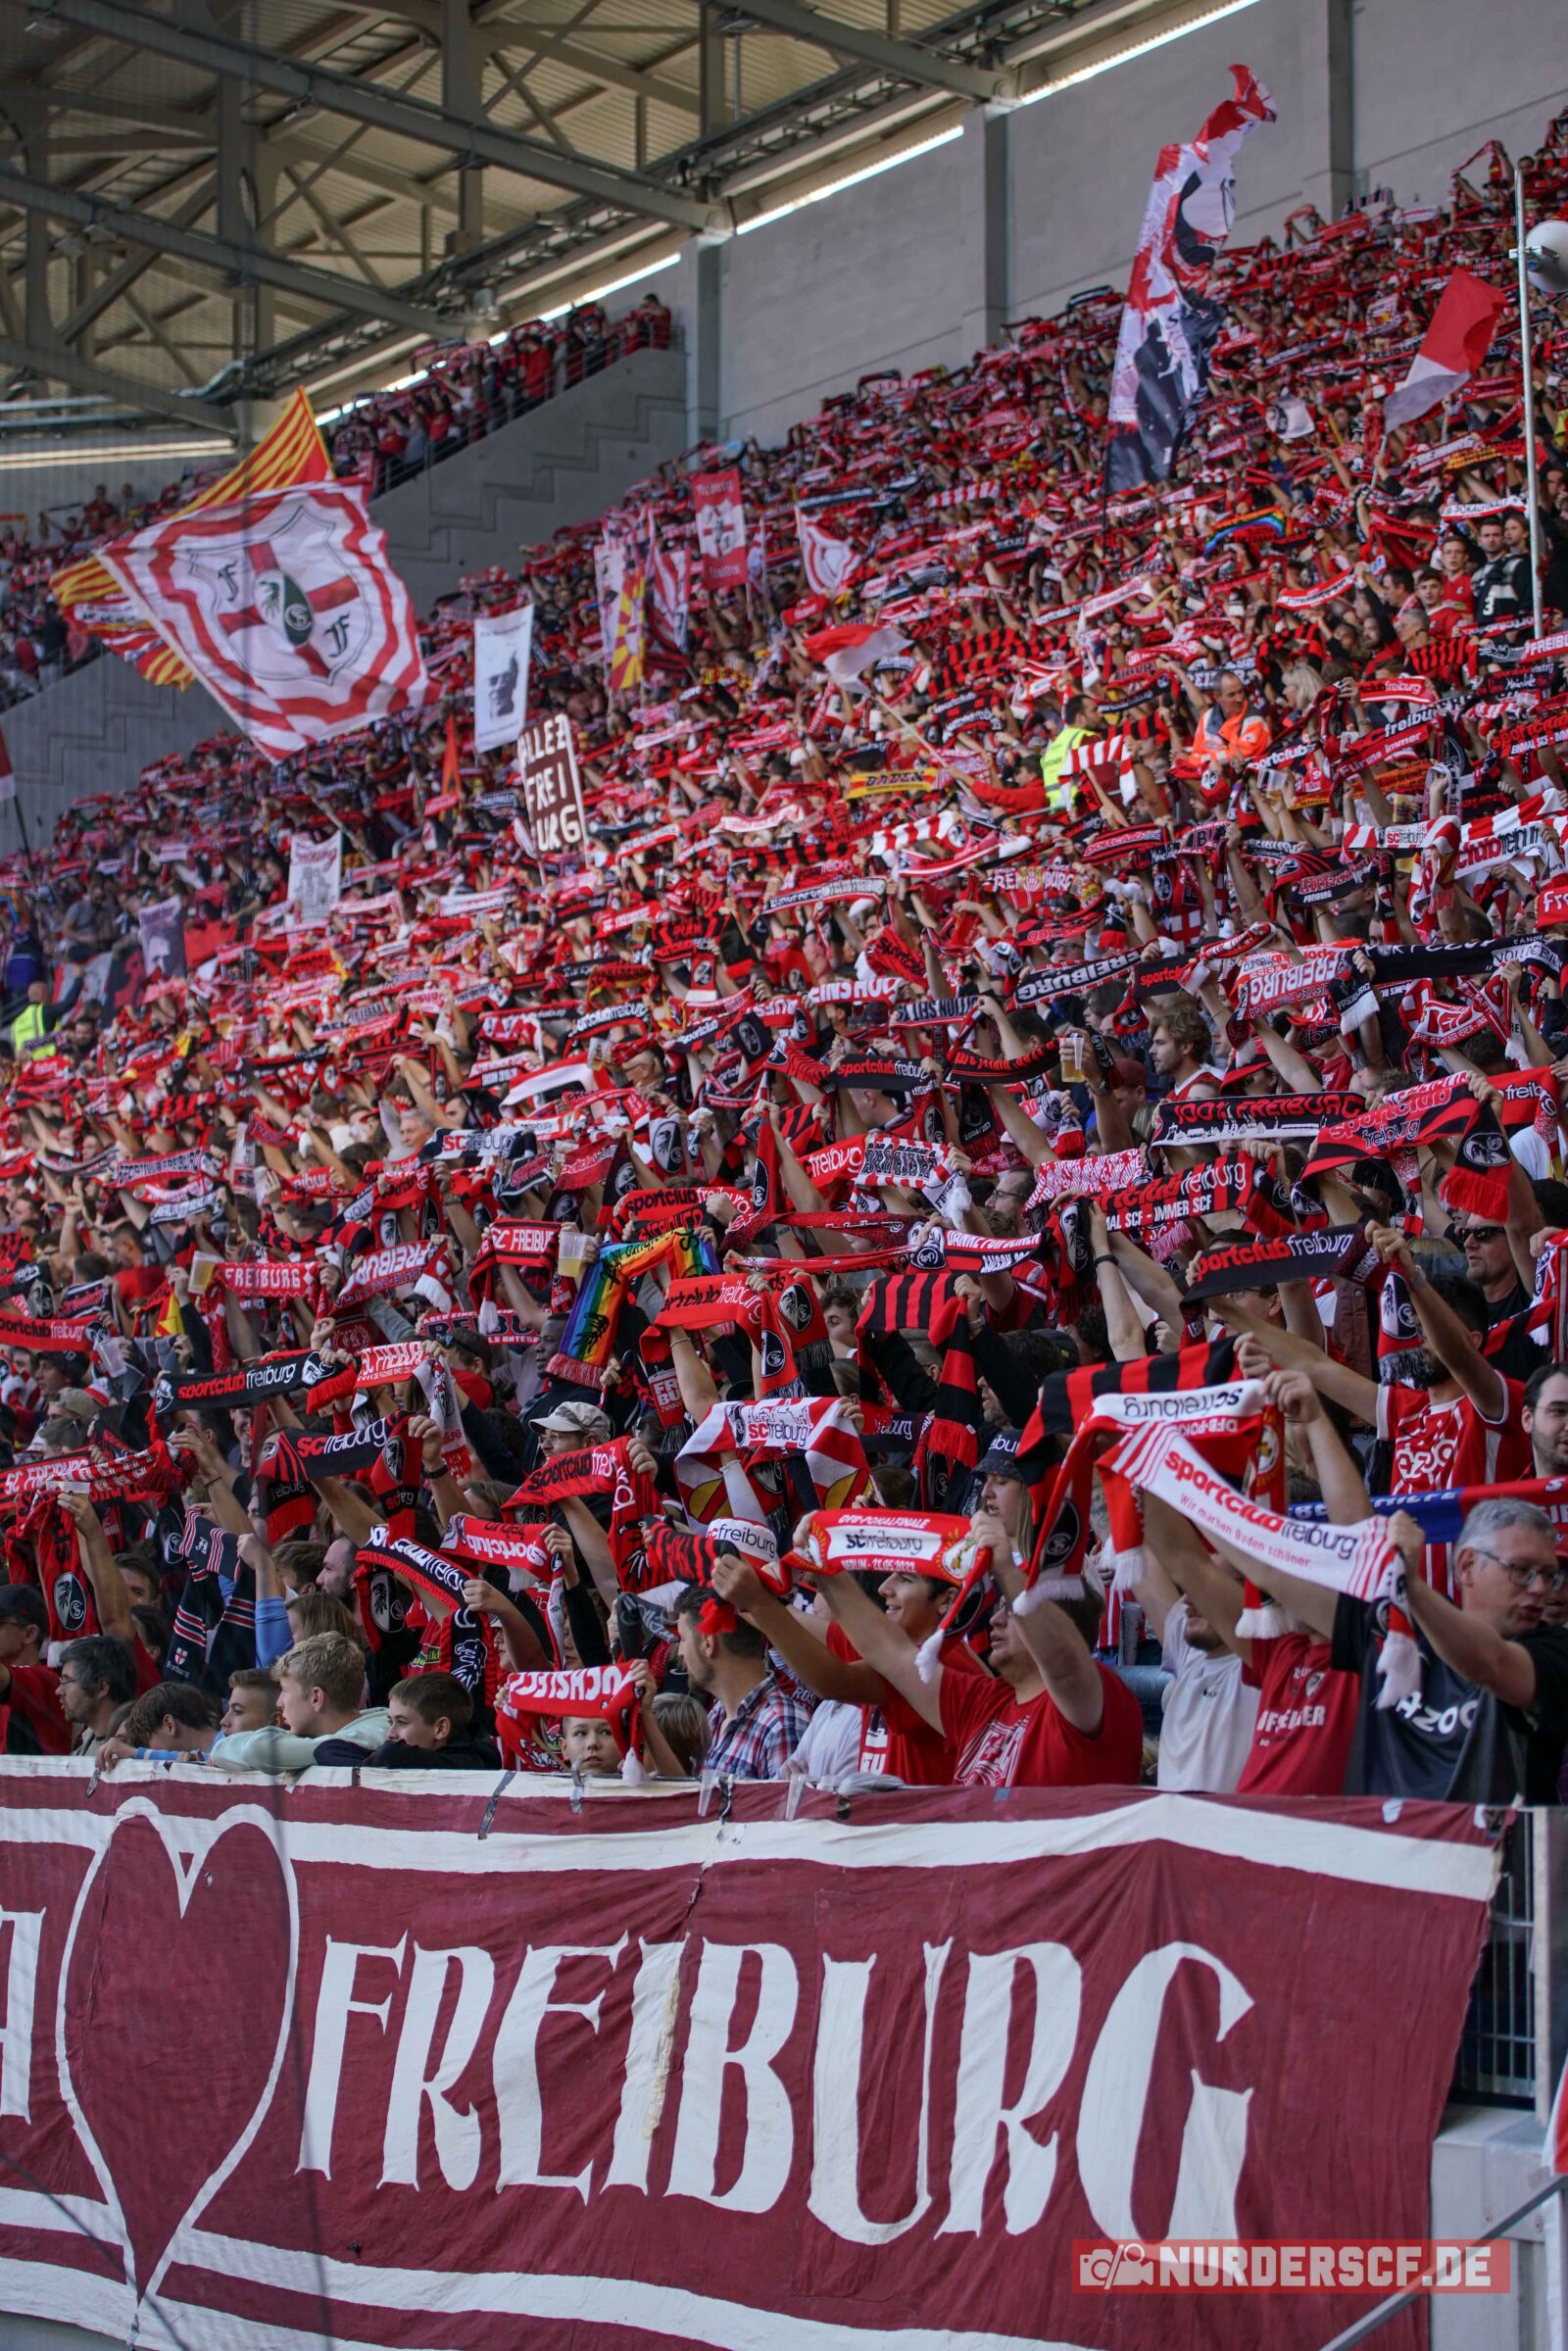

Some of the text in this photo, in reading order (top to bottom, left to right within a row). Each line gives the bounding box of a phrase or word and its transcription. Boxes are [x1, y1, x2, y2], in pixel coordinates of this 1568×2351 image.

[1482, 596, 1494, 615] 3
[1384, 732, 1422, 753] immer
[1387, 834, 1400, 844] SC
[1017, 948, 1141, 1001] FREIBURG
[1250, 952, 1339, 1005] FREIBURG
[837, 1058, 895, 1077] sportclub
[1236, 1094, 1365, 1119] FREIBURG
[1329, 1088, 1452, 1139] sportclub
[442, 1134, 467, 1152] SC
[1362, 1117, 1421, 1150] freiburg
[1180, 1162, 1247, 1196] freiburg
[624, 1188, 697, 1215] sportclub
[1124, 1210, 1144, 1226] SCF
[1153, 1200, 1190, 1222] IMMER
[1192, 1194, 1213, 1212] SCF
[490, 1227, 510, 1249] SC
[1288, 1231, 1354, 1258] freiburg
[224, 1266, 301, 1290] FREIBURG
[50, 1320, 85, 1342] freiburg
[177, 1362, 297, 1399] sportclub freiburg
[296, 1416, 389, 1458] SC freiburg
[748, 1421, 810, 1447] SC freiburg
[5, 1470, 24, 1495] SC
[1164, 1448, 1359, 1560] sportclub freiburg
[1179, 1493, 1198, 1514] Wir
[1198, 1505, 1234, 1536] machen
[1234, 1526, 1266, 1551] Baden
[466, 1533, 549, 1566] sportclub
[717, 1523, 777, 1557] freiburg
[845, 1529, 922, 1555] sc freiburg
[294, 1929, 1255, 2283] FREIBURG
